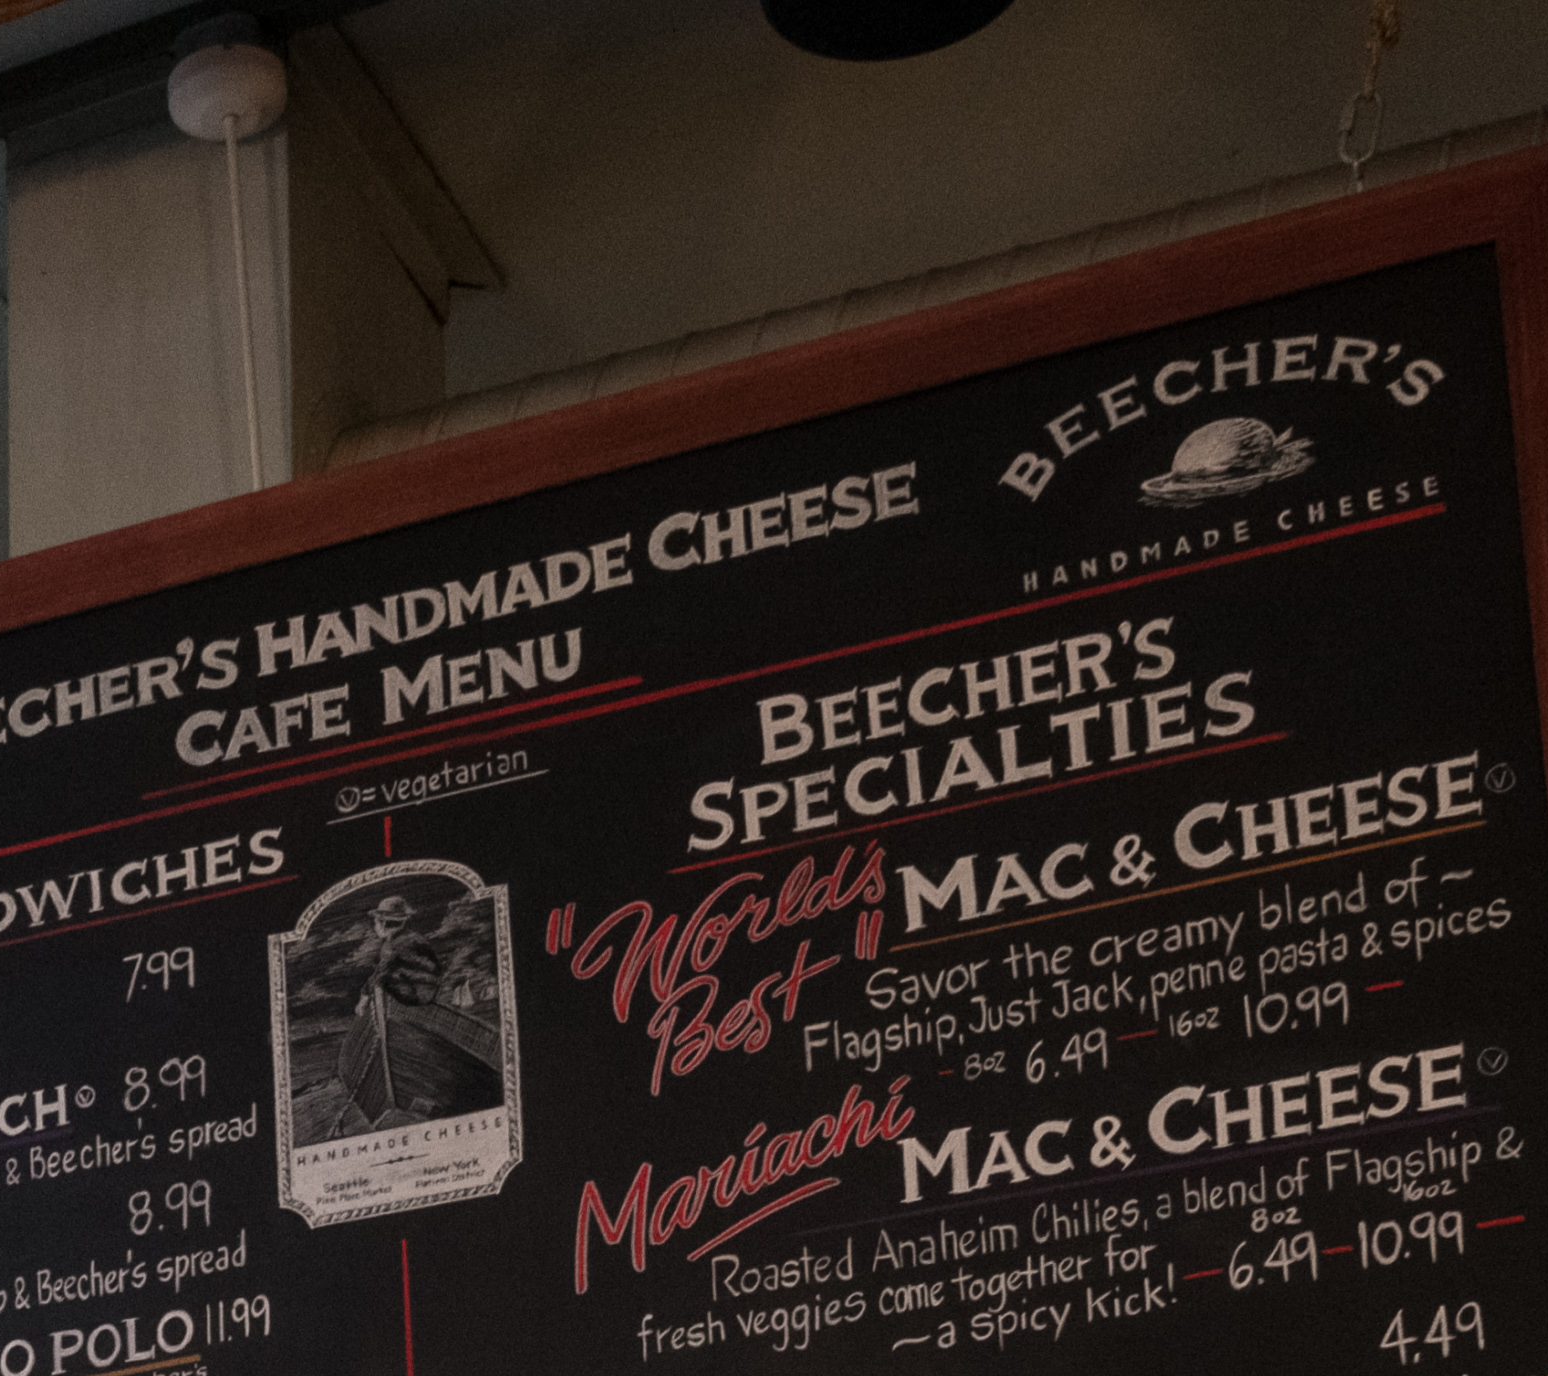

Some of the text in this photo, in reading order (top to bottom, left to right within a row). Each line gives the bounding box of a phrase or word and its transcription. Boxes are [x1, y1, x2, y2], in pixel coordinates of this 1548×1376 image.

[999, 334, 1446, 503] BEECHER'S
[255, 534, 634, 678] HANDMADE
[648, 462, 918, 571] CHEESE
[1023, 476, 1440, 593] HANDMADE CHEESE
[175, 628, 585, 767] CAFE MENU
[757, 616, 1176, 764] BEECHER'S
[688, 670, 1257, 852] SPECIALTIES
[895, 752, 1482, 933] MAC & CHEESE
[123, 945, 196, 1003] 7.99
[123, 1054, 207, 1114] 8.99
[1026, 1028, 1108, 1084] 6.49
[1244, 982, 1348, 1038] 10.99
[898, 1044, 1467, 1203] MAC & CHEESE
[128, 1179, 212, 1236] 8.99
[574, 1076, 916, 1295] Mariachi
[15, 1282, 31, 1308] &
[36, 1252, 147, 1305] Beecher's
[157, 1229, 247, 1284] spread
[1228, 1210, 1465, 1290] 6.49 10.99
[51, 1309, 194, 1375] POLO
[205, 1294, 272, 1345] 11.99
[1379, 1300, 1486, 1365] 4.49
